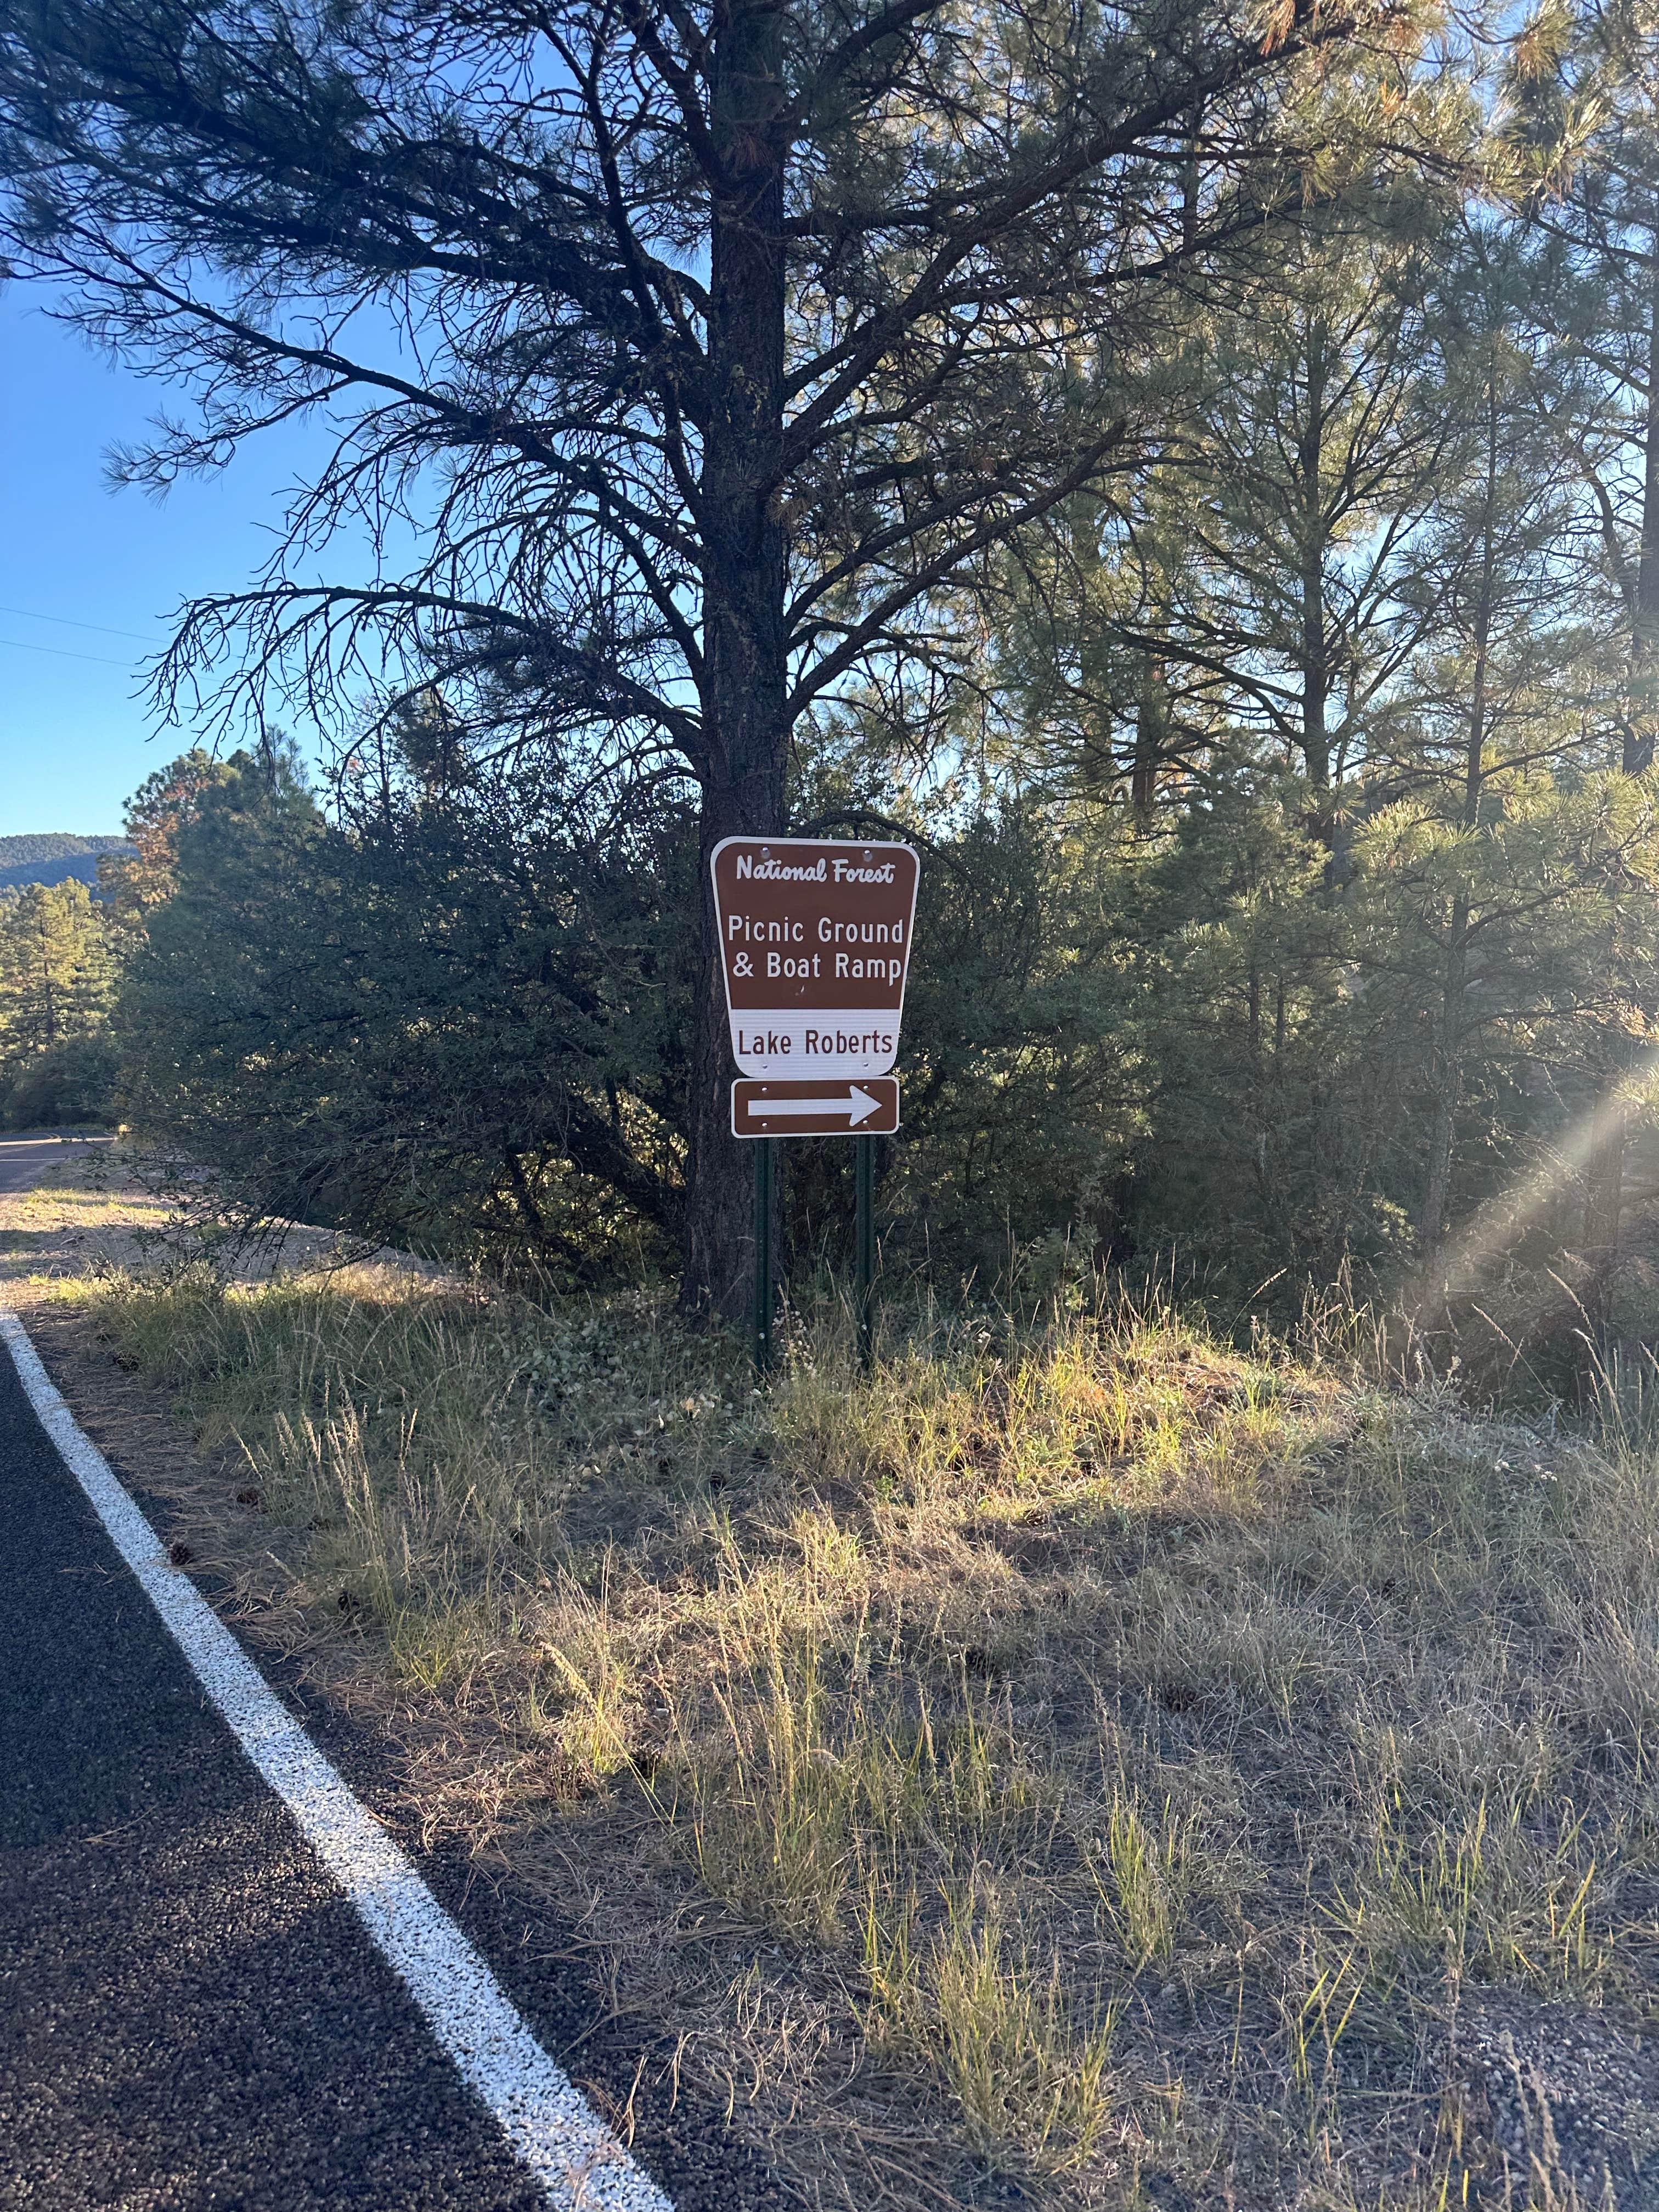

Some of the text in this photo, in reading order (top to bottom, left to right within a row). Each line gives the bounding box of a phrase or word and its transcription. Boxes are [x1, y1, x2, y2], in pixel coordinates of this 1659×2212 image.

[736, 855, 895, 884] National Forest
[729, 915, 904, 944] Picnic Ground
[733, 952, 901, 986] & Boat Ramp
[738, 1030, 893, 1055] Lake Roberts
